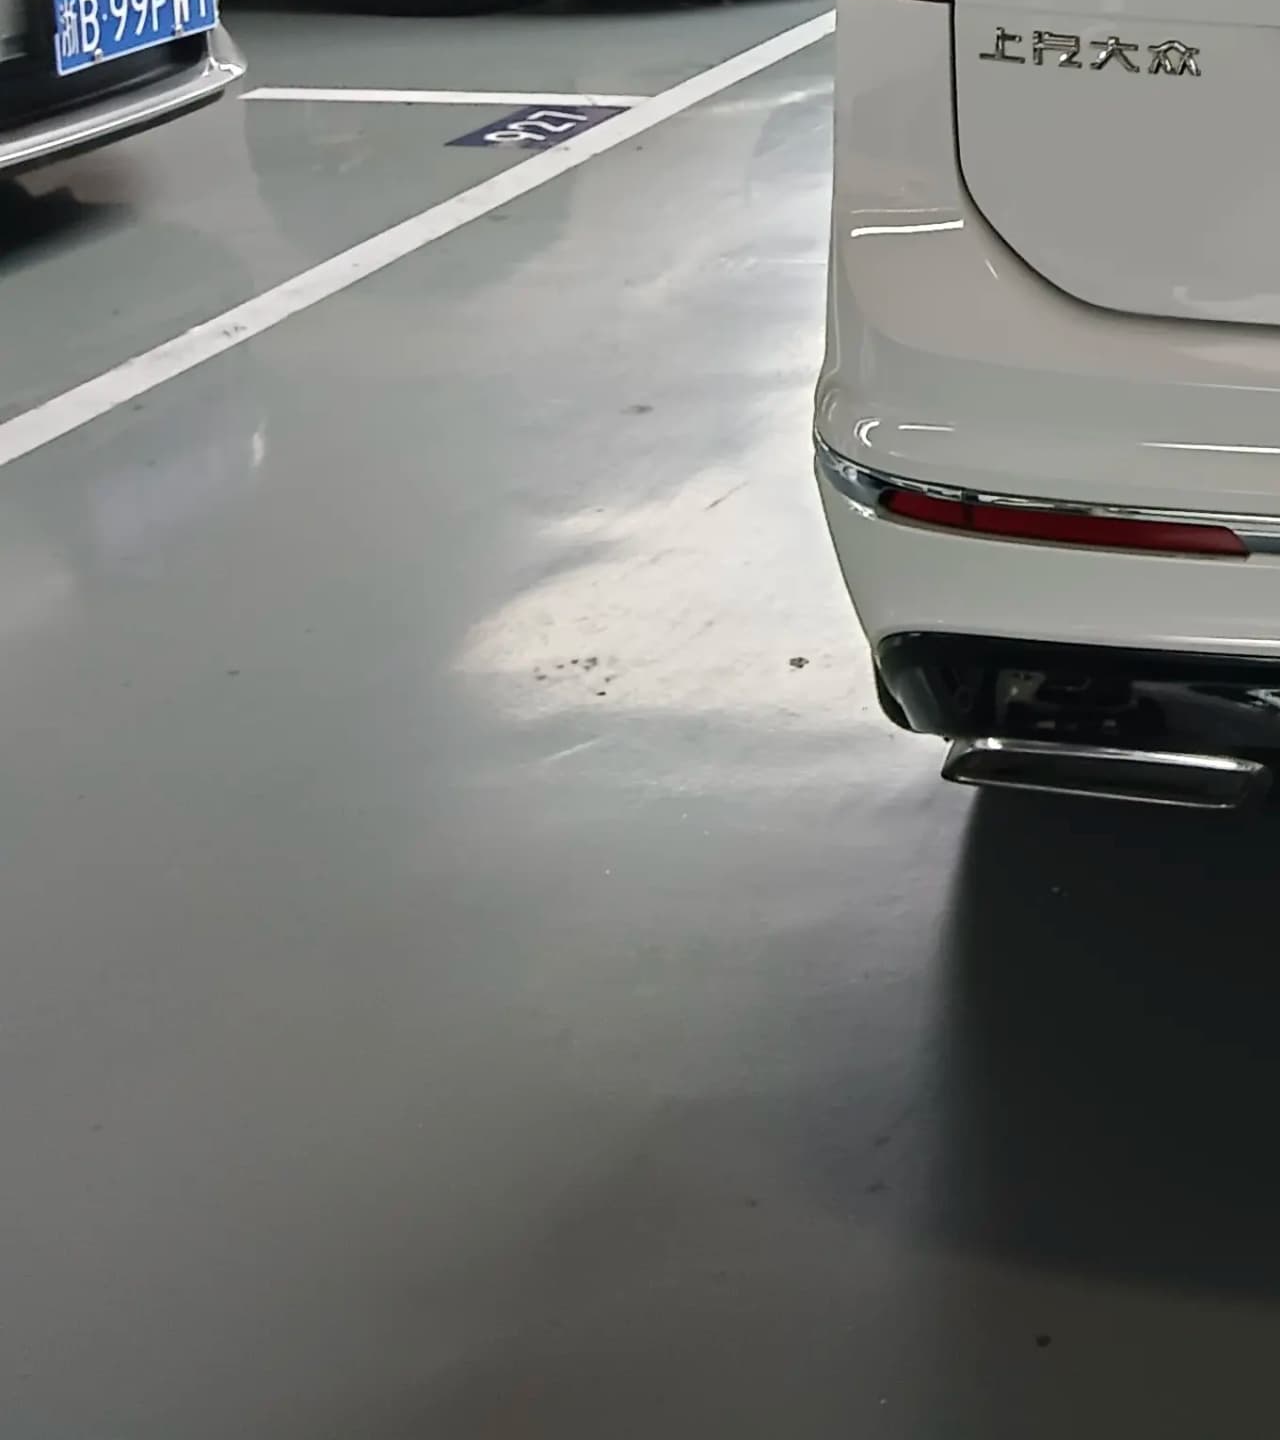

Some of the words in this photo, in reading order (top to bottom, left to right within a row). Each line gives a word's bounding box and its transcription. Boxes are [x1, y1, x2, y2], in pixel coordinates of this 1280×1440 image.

[979, 26, 1202, 77] 上汽大众
[483, 110, 588, 142] 927
